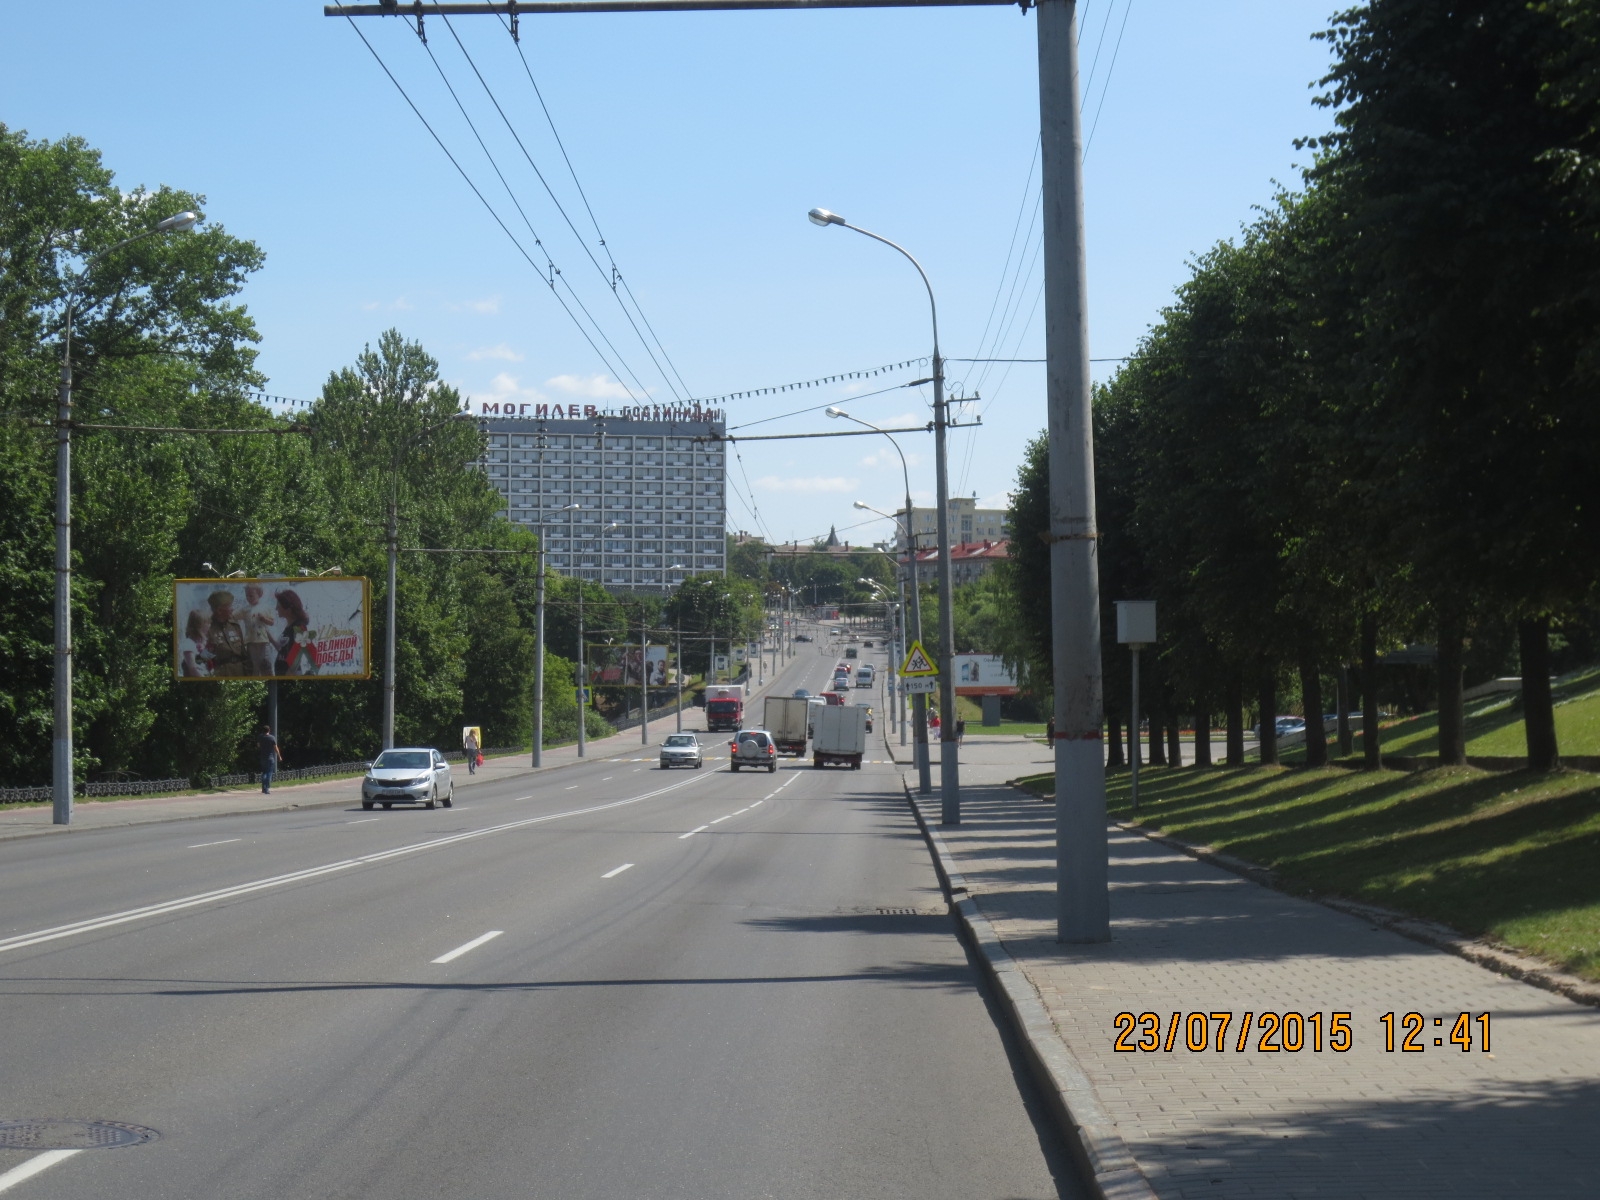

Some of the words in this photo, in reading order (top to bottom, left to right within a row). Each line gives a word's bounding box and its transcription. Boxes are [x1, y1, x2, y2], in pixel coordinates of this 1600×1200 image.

[482, 402, 597, 417] МОГИЛЕВ
[317, 635, 357, 652] ВЕЛИКОЙ
[317, 649, 354, 665] ПОБЕДЫ
